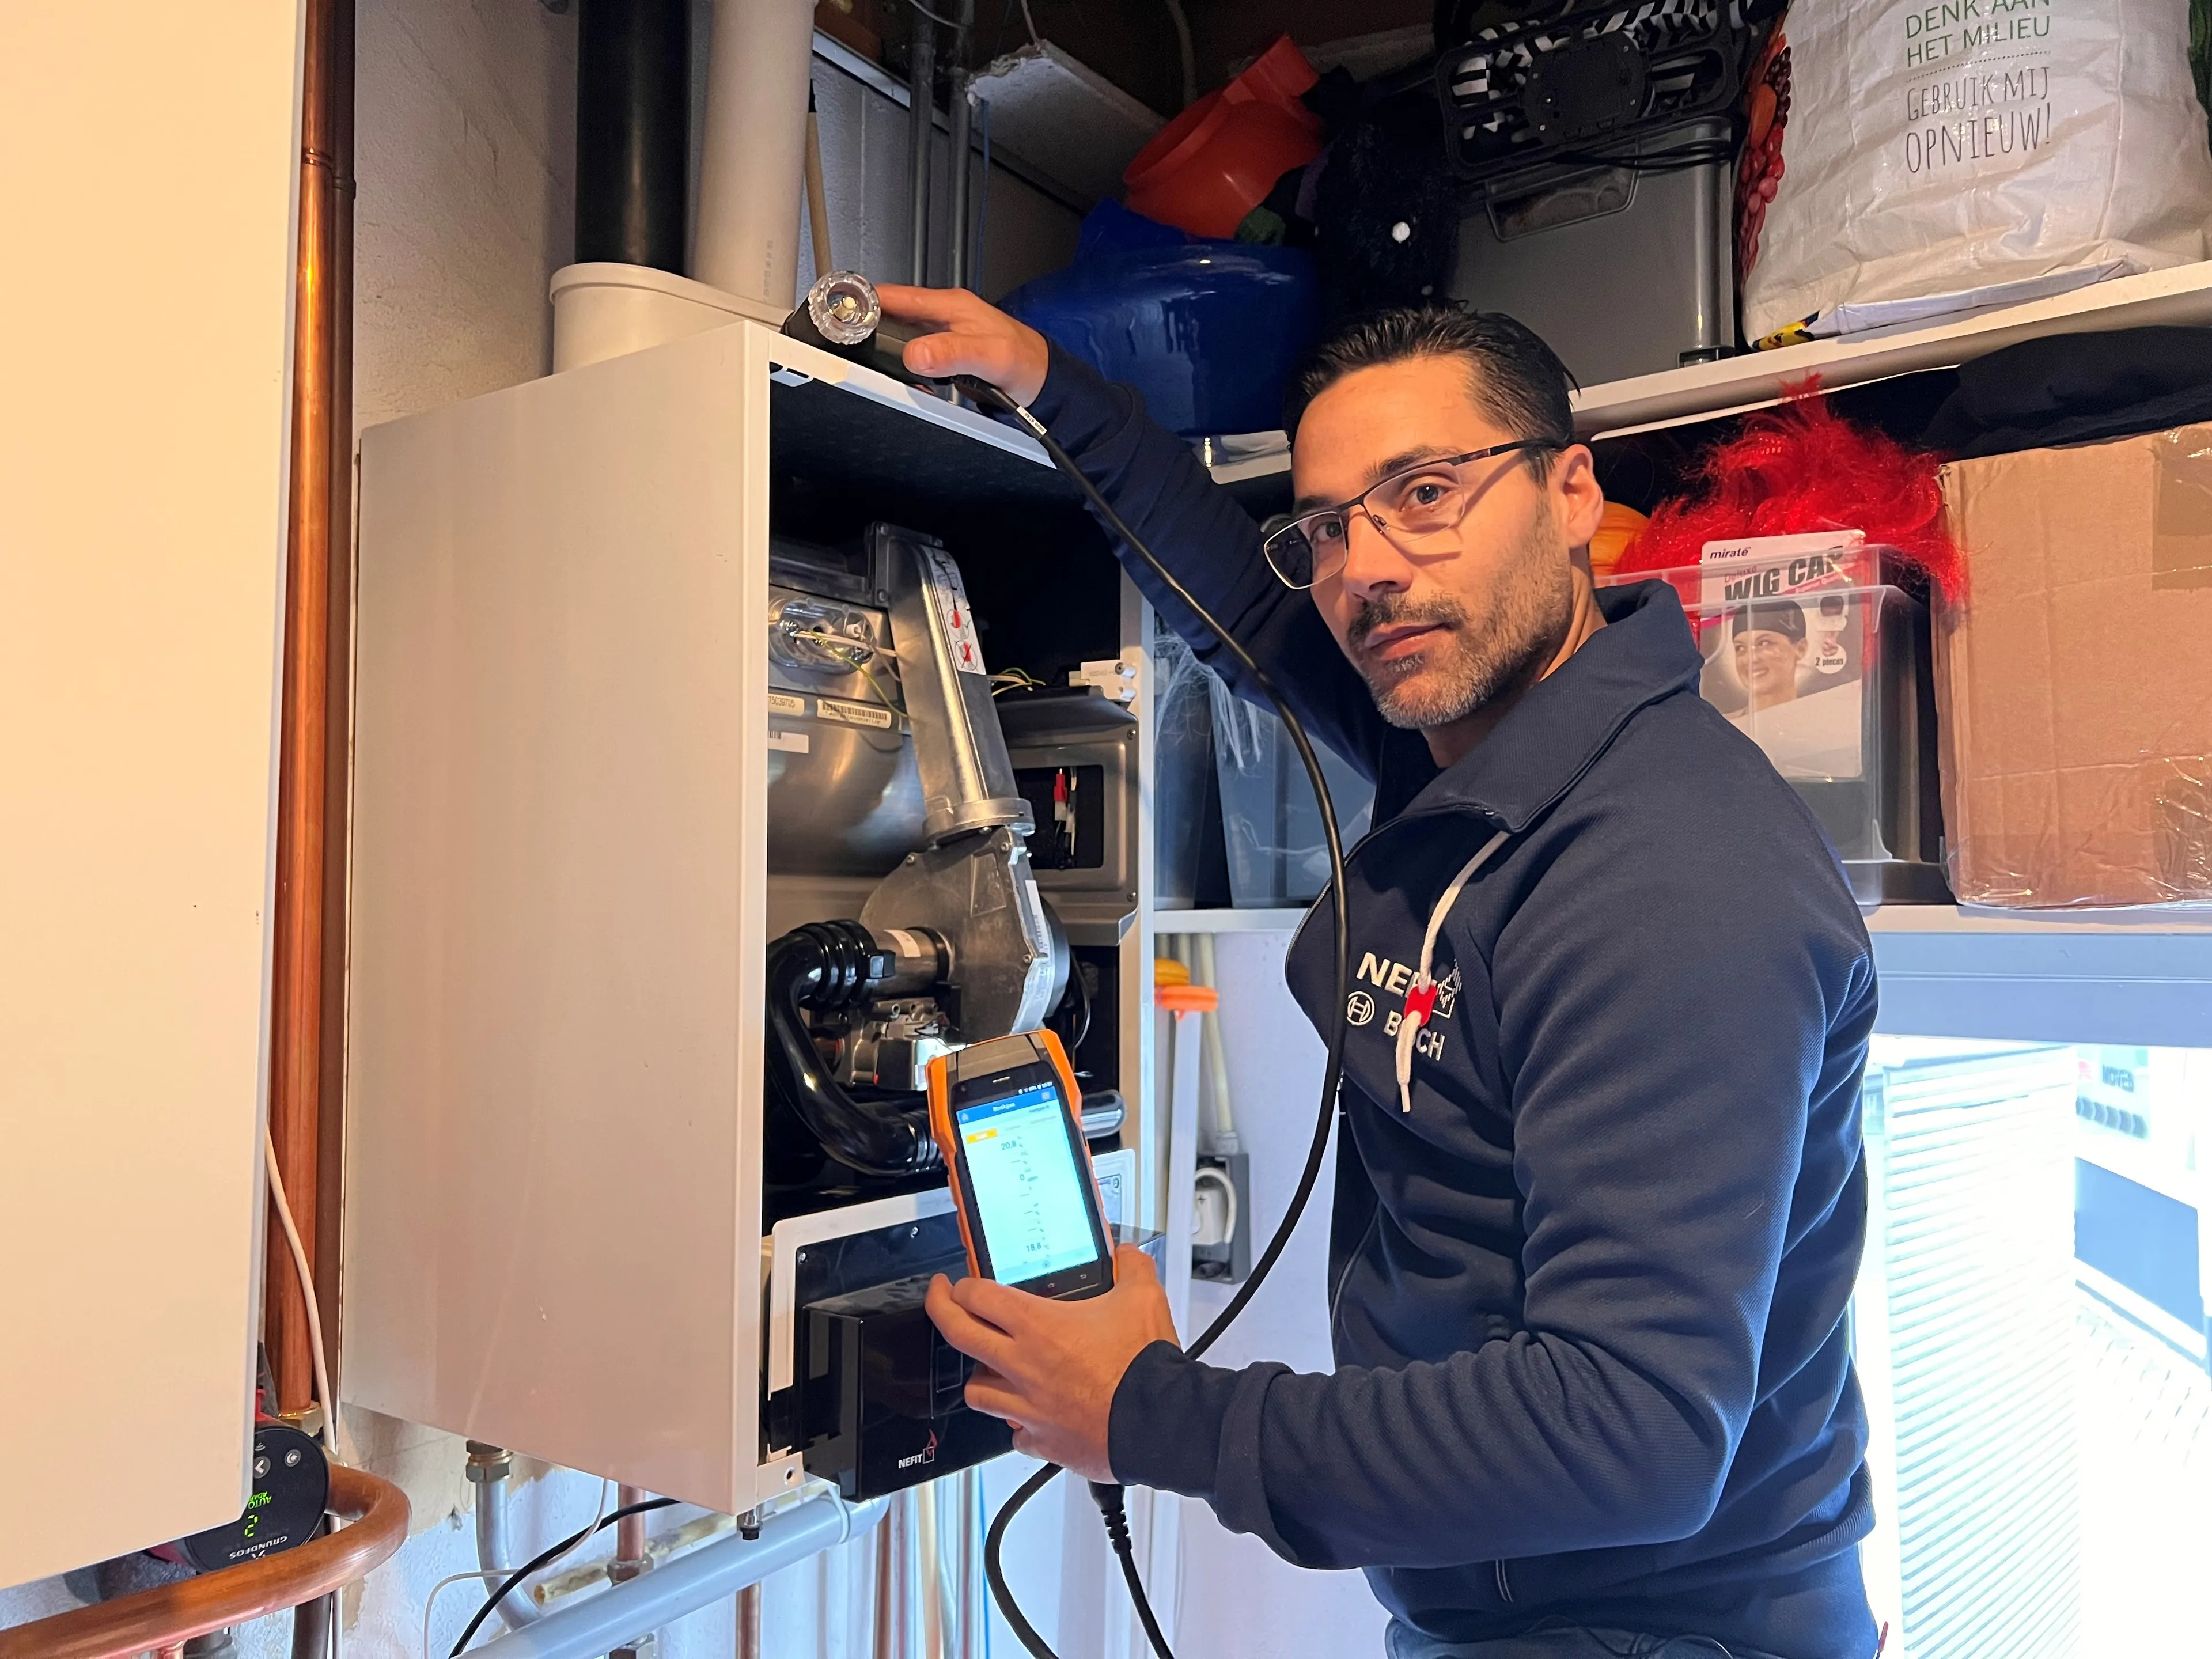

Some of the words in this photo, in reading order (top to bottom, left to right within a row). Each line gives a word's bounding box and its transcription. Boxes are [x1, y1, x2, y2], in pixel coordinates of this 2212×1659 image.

[1906, 0, 1980, 39] DENK
[1907, 33, 1953, 67] HET
[1963, 15, 2050, 50] MILIEU
[1907, 74, 1994, 121] GEBRUIK
[2004, 66, 2050, 101] MIJ
[1906, 101, 2051, 173] OPNIEUW!
[1725, 568, 1780, 601] WIG
[1788, 545, 1843, 586] CAP
[1815, 657, 1820, 666] 2
[1383, 1010, 1445, 1061] BCH
[899, 1453, 922, 1468] NEFIT
[248, 1496, 272, 1509] AUTO
[229, 1536, 287, 1559] GRUNDFOS
